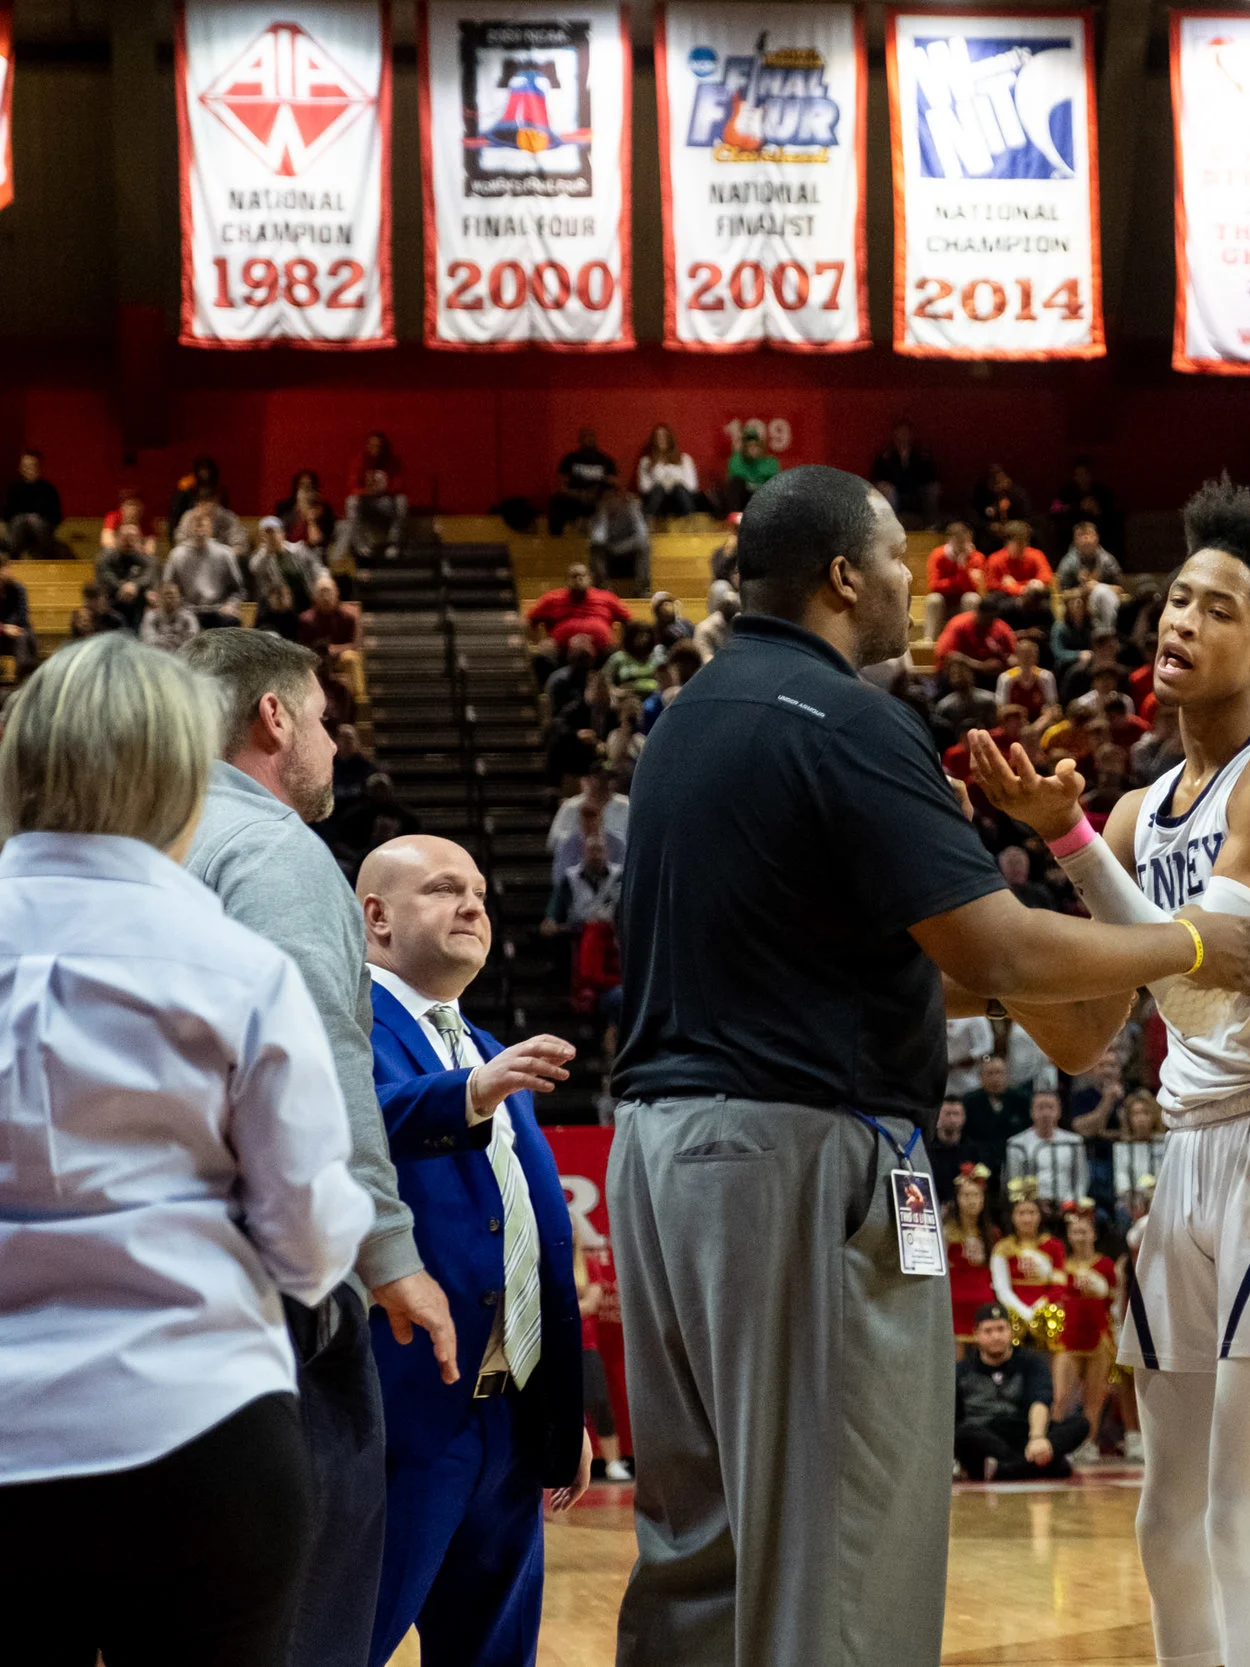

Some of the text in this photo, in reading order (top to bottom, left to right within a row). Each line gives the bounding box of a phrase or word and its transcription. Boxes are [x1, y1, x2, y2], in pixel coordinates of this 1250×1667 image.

[229, 189, 344, 211] NATIONAL
[710, 181, 821, 205] NATIONAL
[716, 213, 815, 237] FINALIST
[935, 204, 1060, 223] NATIONAL
[221, 222, 353, 245] CHAMPION
[463, 216, 596, 238] FINAL FOUR
[926, 235, 1071, 254] CHAMPION
[212, 257, 365, 309] 1982
[446, 259, 614, 312] 2000
[686, 260, 846, 312] 2007
[912, 276, 1085, 322] 2014
[777, 694, 799, 705] UNDER
